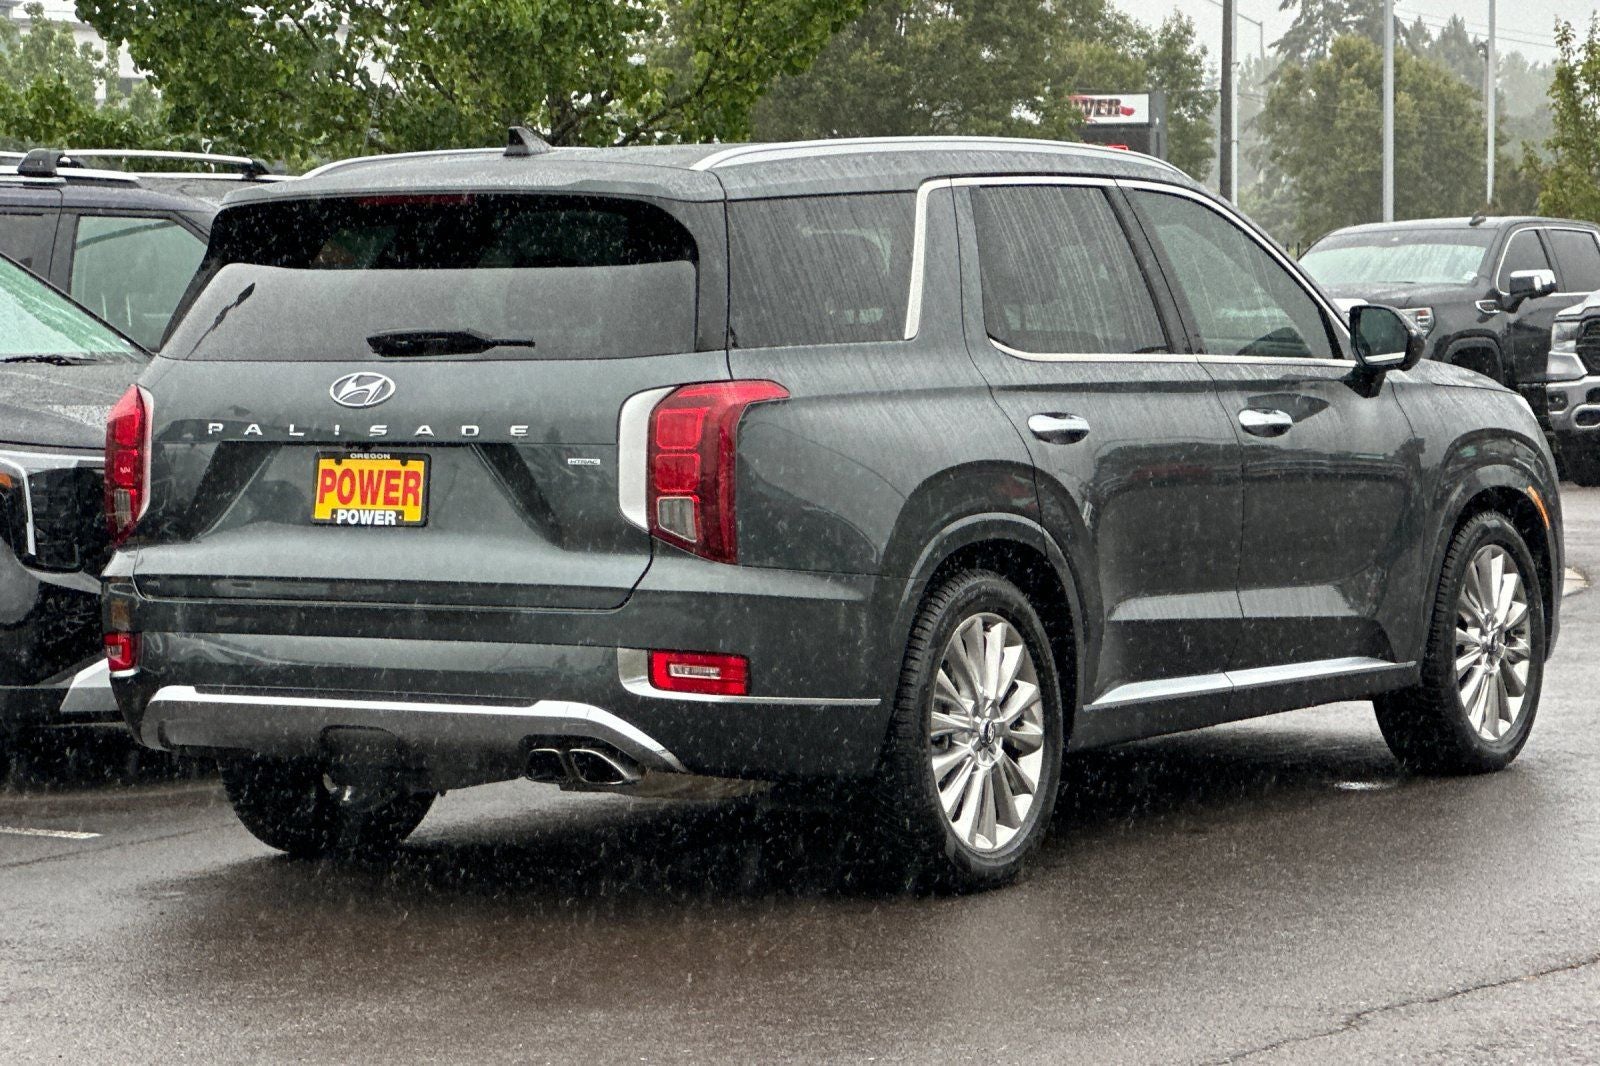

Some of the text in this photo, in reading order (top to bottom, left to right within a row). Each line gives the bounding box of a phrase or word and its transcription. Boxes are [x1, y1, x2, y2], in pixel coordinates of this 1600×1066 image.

[207, 422, 529, 437] PALISADE
[349, 452, 391, 460] OREGON
[318, 467, 422, 507] POWER
[336, 509, 397, 526] POWER
